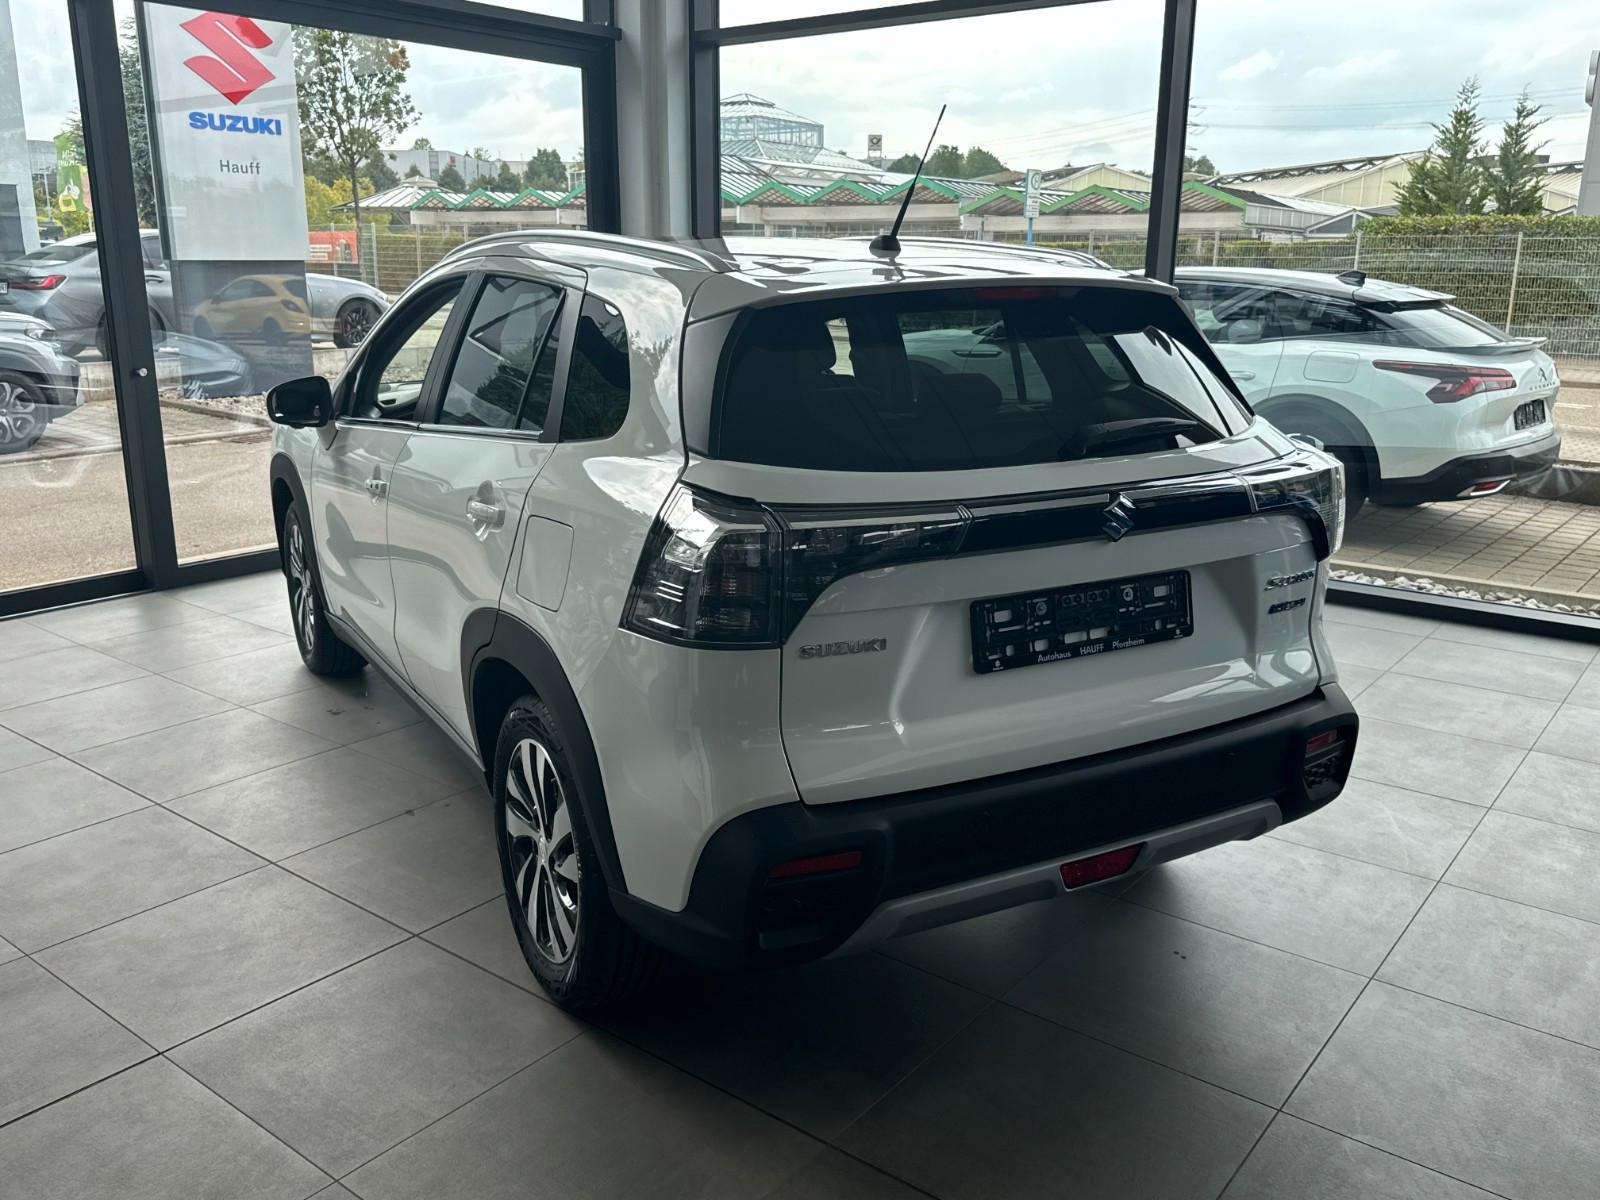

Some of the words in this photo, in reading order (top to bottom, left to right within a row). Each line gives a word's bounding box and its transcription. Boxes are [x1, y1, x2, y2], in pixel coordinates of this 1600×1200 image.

[188, 111, 282, 136] SUZUKI
[219, 159, 261, 175] Hauff
[798, 638, 887, 660] SUZUKI
[1037, 650, 1072, 663] Autohaus
[1079, 643, 1105, 656] HAUFF
[1112, 637, 1145, 650] Pforzheim
